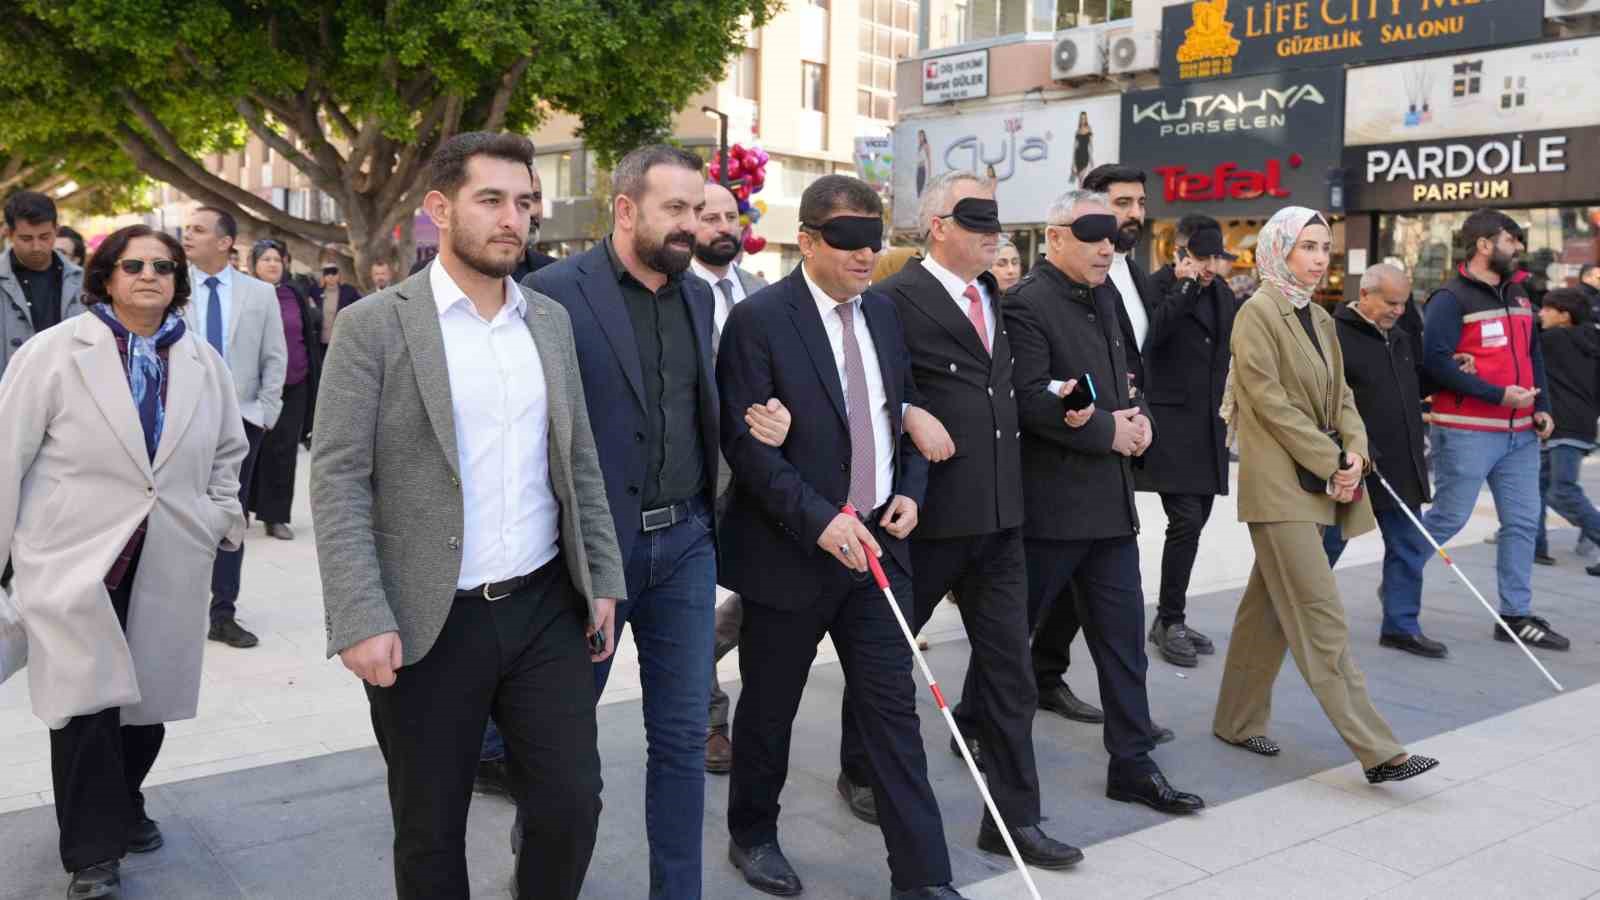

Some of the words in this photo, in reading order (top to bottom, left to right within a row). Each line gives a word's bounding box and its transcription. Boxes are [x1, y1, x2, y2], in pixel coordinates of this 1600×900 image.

[1277, 30, 1362, 56] GÜZELLİK
[1381, 16, 1464, 43] SALONU
[952, 73, 984, 89] GÜLER
[1160, 114, 1285, 137] PORSELEN
[1154, 158, 1291, 204] Tefal
[1413, 180, 1509, 201] PARFUM
